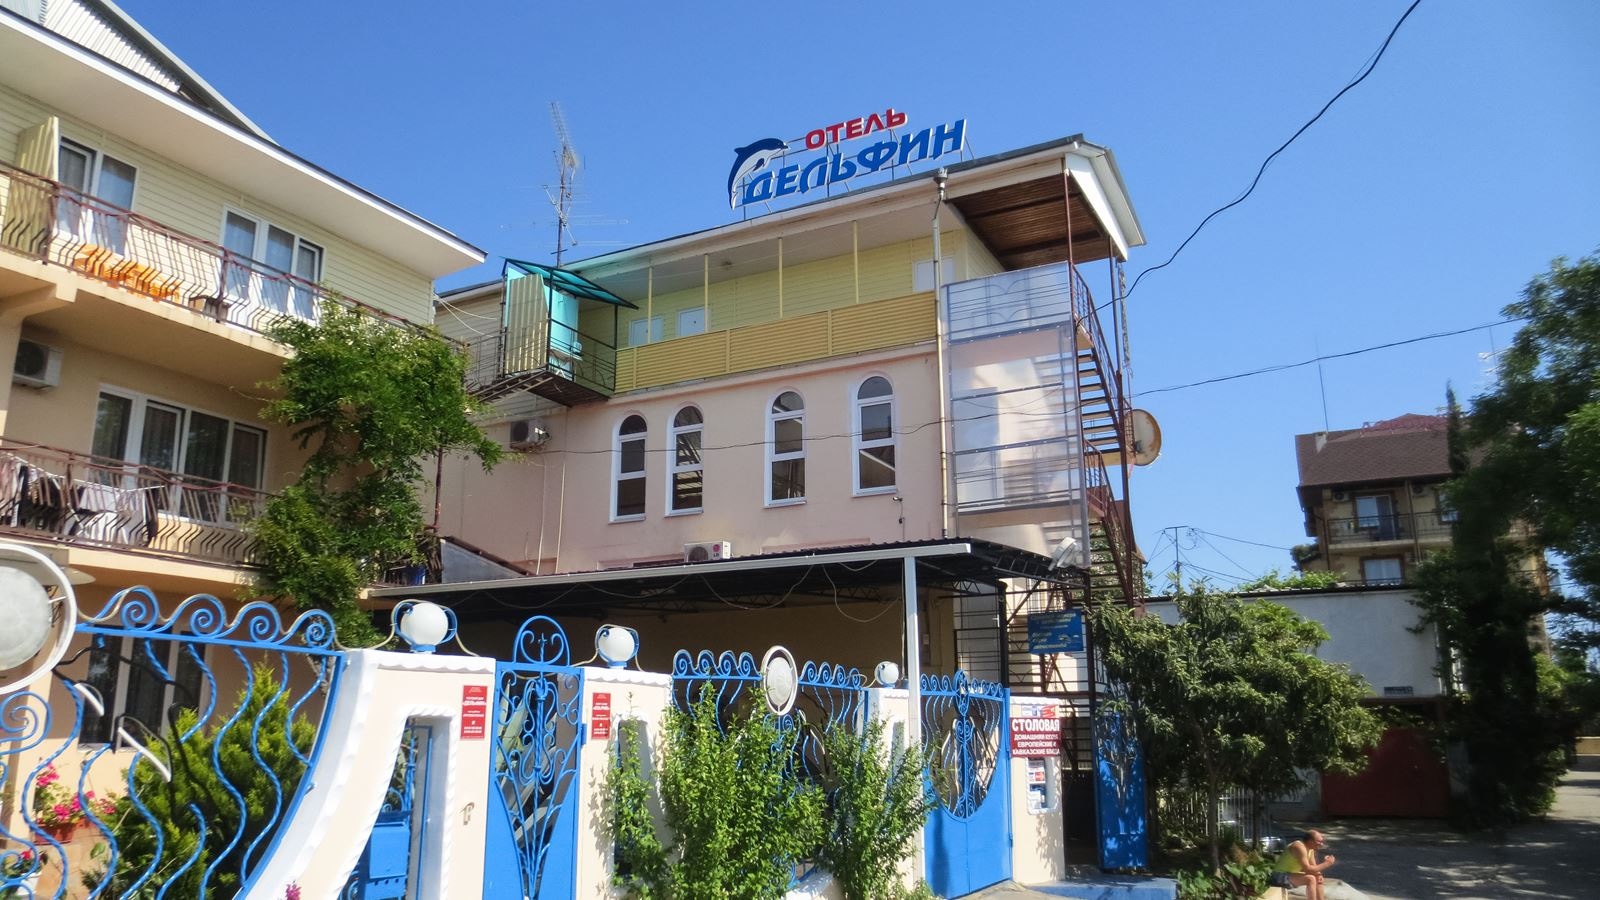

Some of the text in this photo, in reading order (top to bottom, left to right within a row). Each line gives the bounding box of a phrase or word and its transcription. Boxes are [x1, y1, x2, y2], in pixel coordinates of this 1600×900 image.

[805, 108, 907, 150] ОТЕЛЬ
[742, 119, 966, 205] ДЕЛЬФИН
[1012, 718, 1060, 732] СТОЛОВАЯ
[1017, 740, 1052, 748] ЕВРОПЕЙСКИЕ
